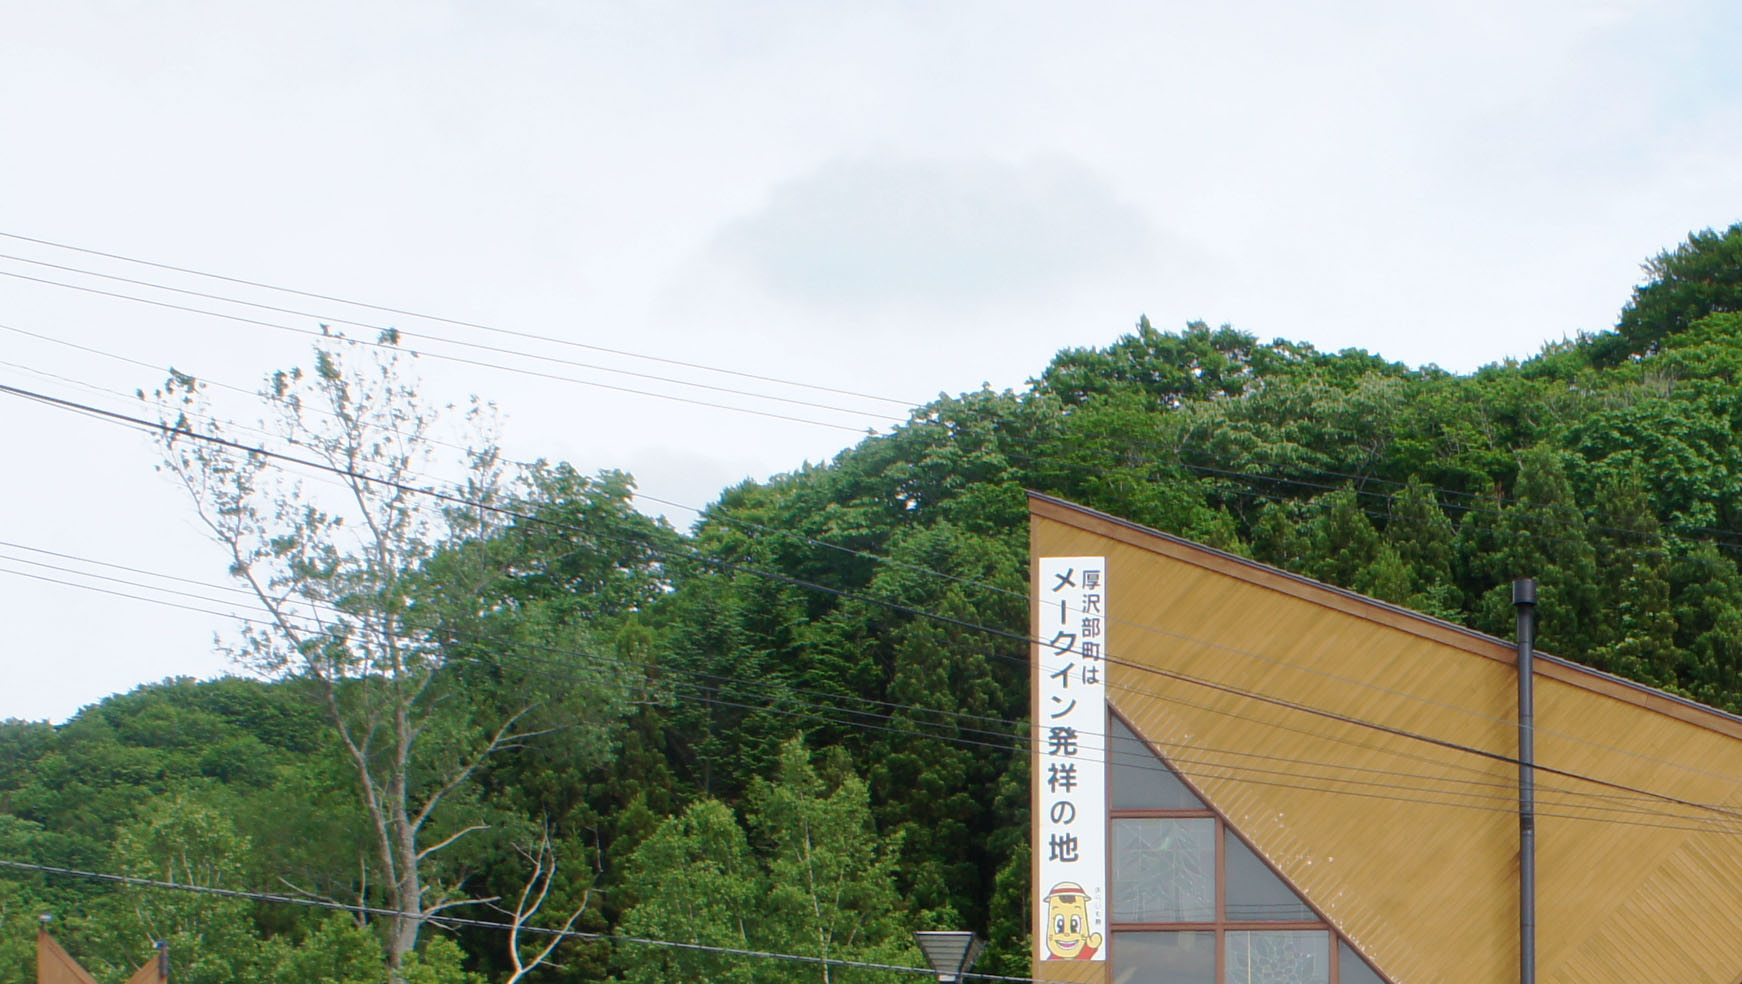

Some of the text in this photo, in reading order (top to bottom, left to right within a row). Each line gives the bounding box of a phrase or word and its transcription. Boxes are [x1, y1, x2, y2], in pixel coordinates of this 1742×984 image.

[1047, 568, 1079, 862] メークイン発祥の地
[1081, 569, 1101, 685] 厚沢部町は
